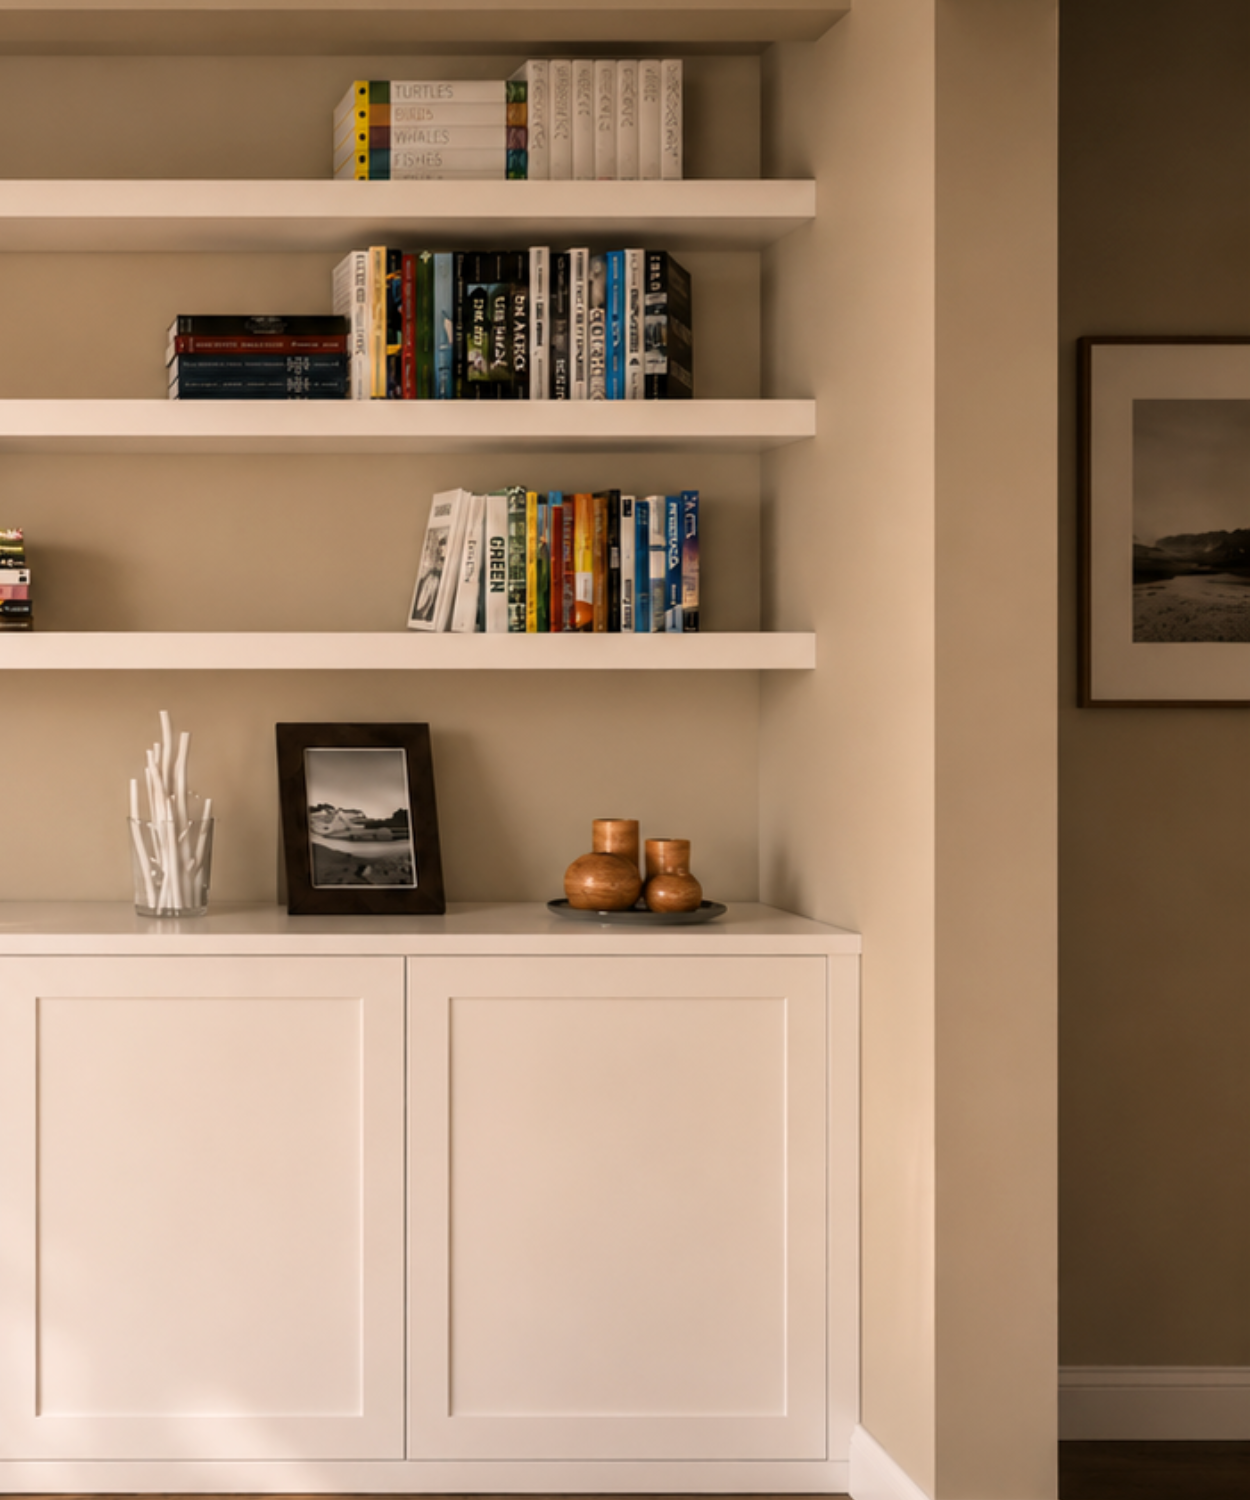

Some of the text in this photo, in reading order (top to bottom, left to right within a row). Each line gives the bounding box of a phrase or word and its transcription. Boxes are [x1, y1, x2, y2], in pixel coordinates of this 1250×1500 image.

[394, 84, 454, 99] TURTLES
[394, 130, 450, 145] WHALES
[394, 152, 443, 167] FISHES
[490, 536, 505, 593] GREEN
